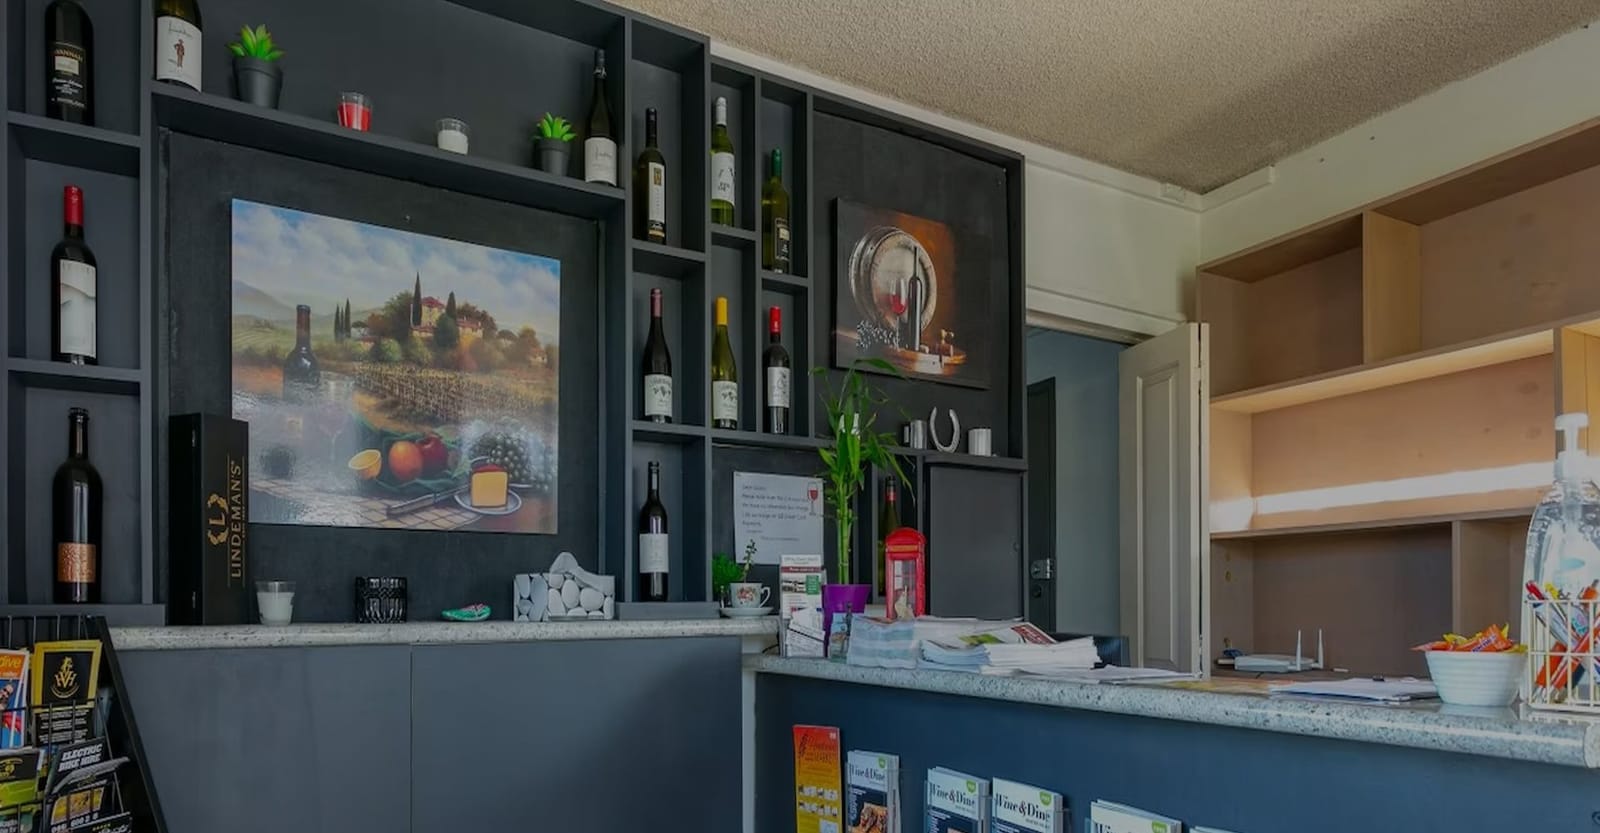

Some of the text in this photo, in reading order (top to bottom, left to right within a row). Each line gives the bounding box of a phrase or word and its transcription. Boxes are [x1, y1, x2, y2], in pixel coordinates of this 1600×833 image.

[231, 465, 242, 580] LINDEMAN'S
[62, 744, 103, 761] ELECTRIC
[58, 753, 102, 773] BIKE HIRE
